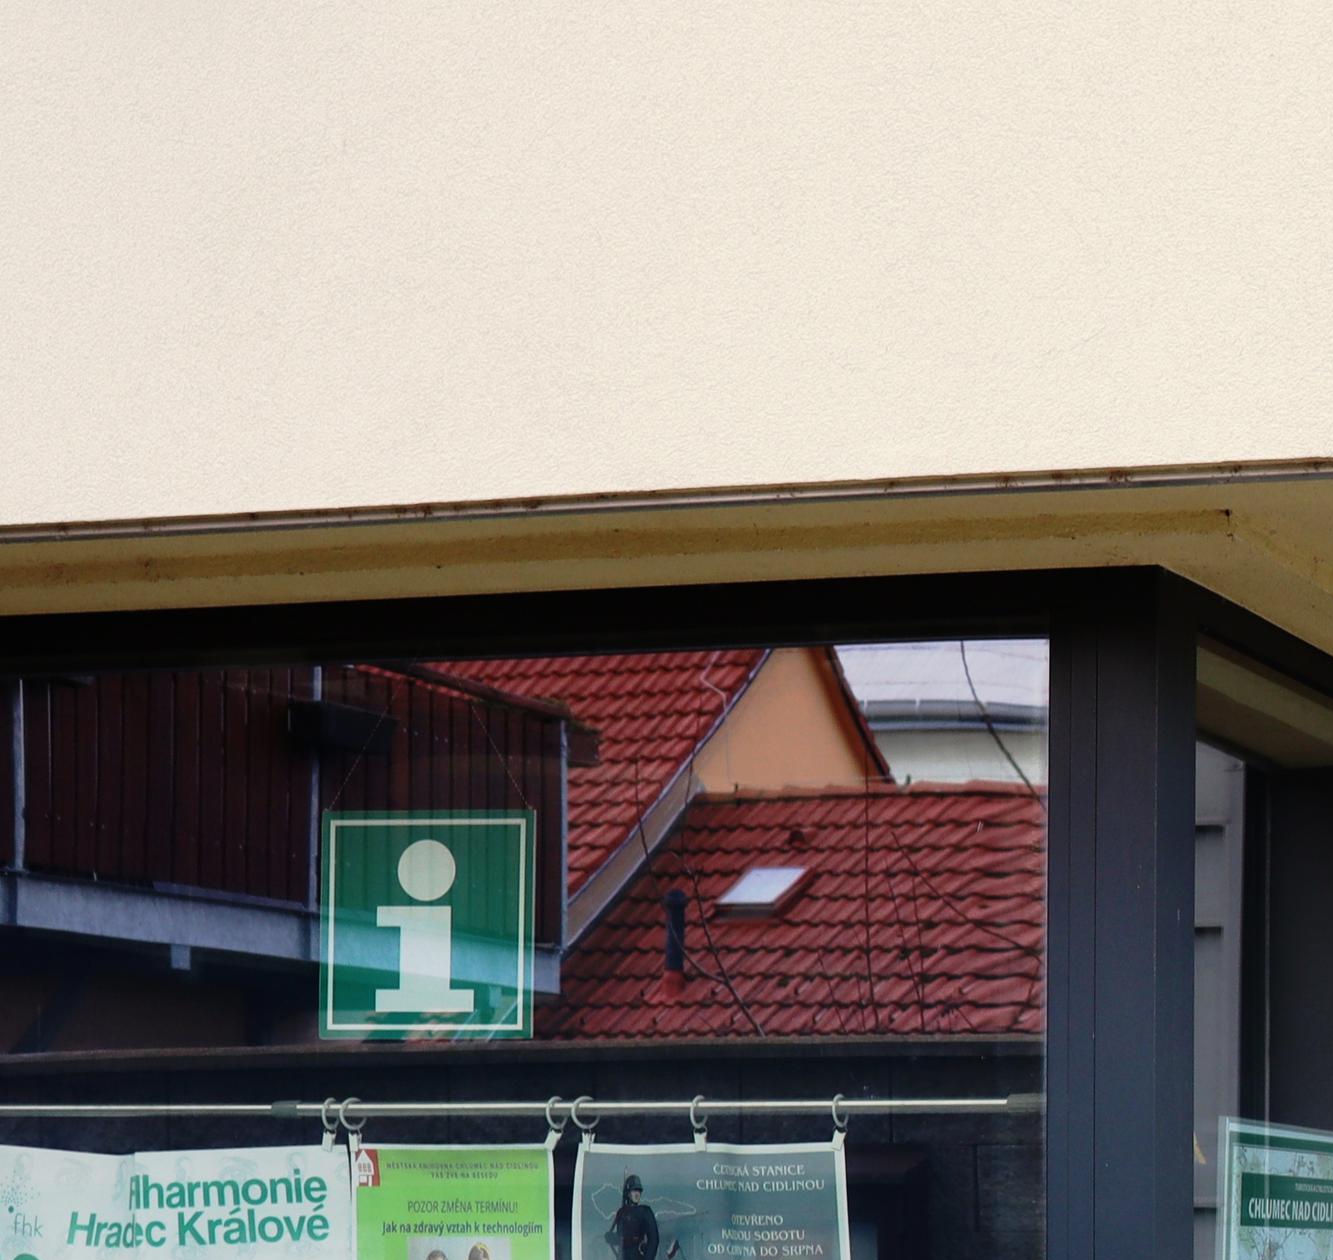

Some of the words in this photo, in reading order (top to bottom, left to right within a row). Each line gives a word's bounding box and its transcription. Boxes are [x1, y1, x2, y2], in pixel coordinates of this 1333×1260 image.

[752, 1163, 806, 1177] STANICE
[738, 1180, 760, 1193] NAD
[762, 1178, 825, 1192] CIDLINOU
[407, 1200, 439, 1214] POZOR
[440, 1198, 473, 1214] ZMĚNA
[475, 1199, 519, 1214] TERMÍNU!
[1249, 1197, 1291, 1220] CHLUMEC
[1291, 1199, 1311, 1221] NAD
[13, 1212, 44, 1238] fhk
[66, 1211, 166, 1249] Hradec
[177, 1204, 330, 1247] Králové
[382, 1221, 398, 1236] Jak
[399, 1223, 411, 1234] na
[413, 1221, 445, 1237] zdravý
[446, 1221, 472, 1234] vztah
[474, 1221, 480, 1234] k
[482, 1221, 543, 1238] technologiím
[753, 1229, 805, 1241] SOBOTU
[707, 1243, 725, 1255] OD
[760, 1245, 778, 1257] DO
[781, 1243, 824, 1257] SRPNA
